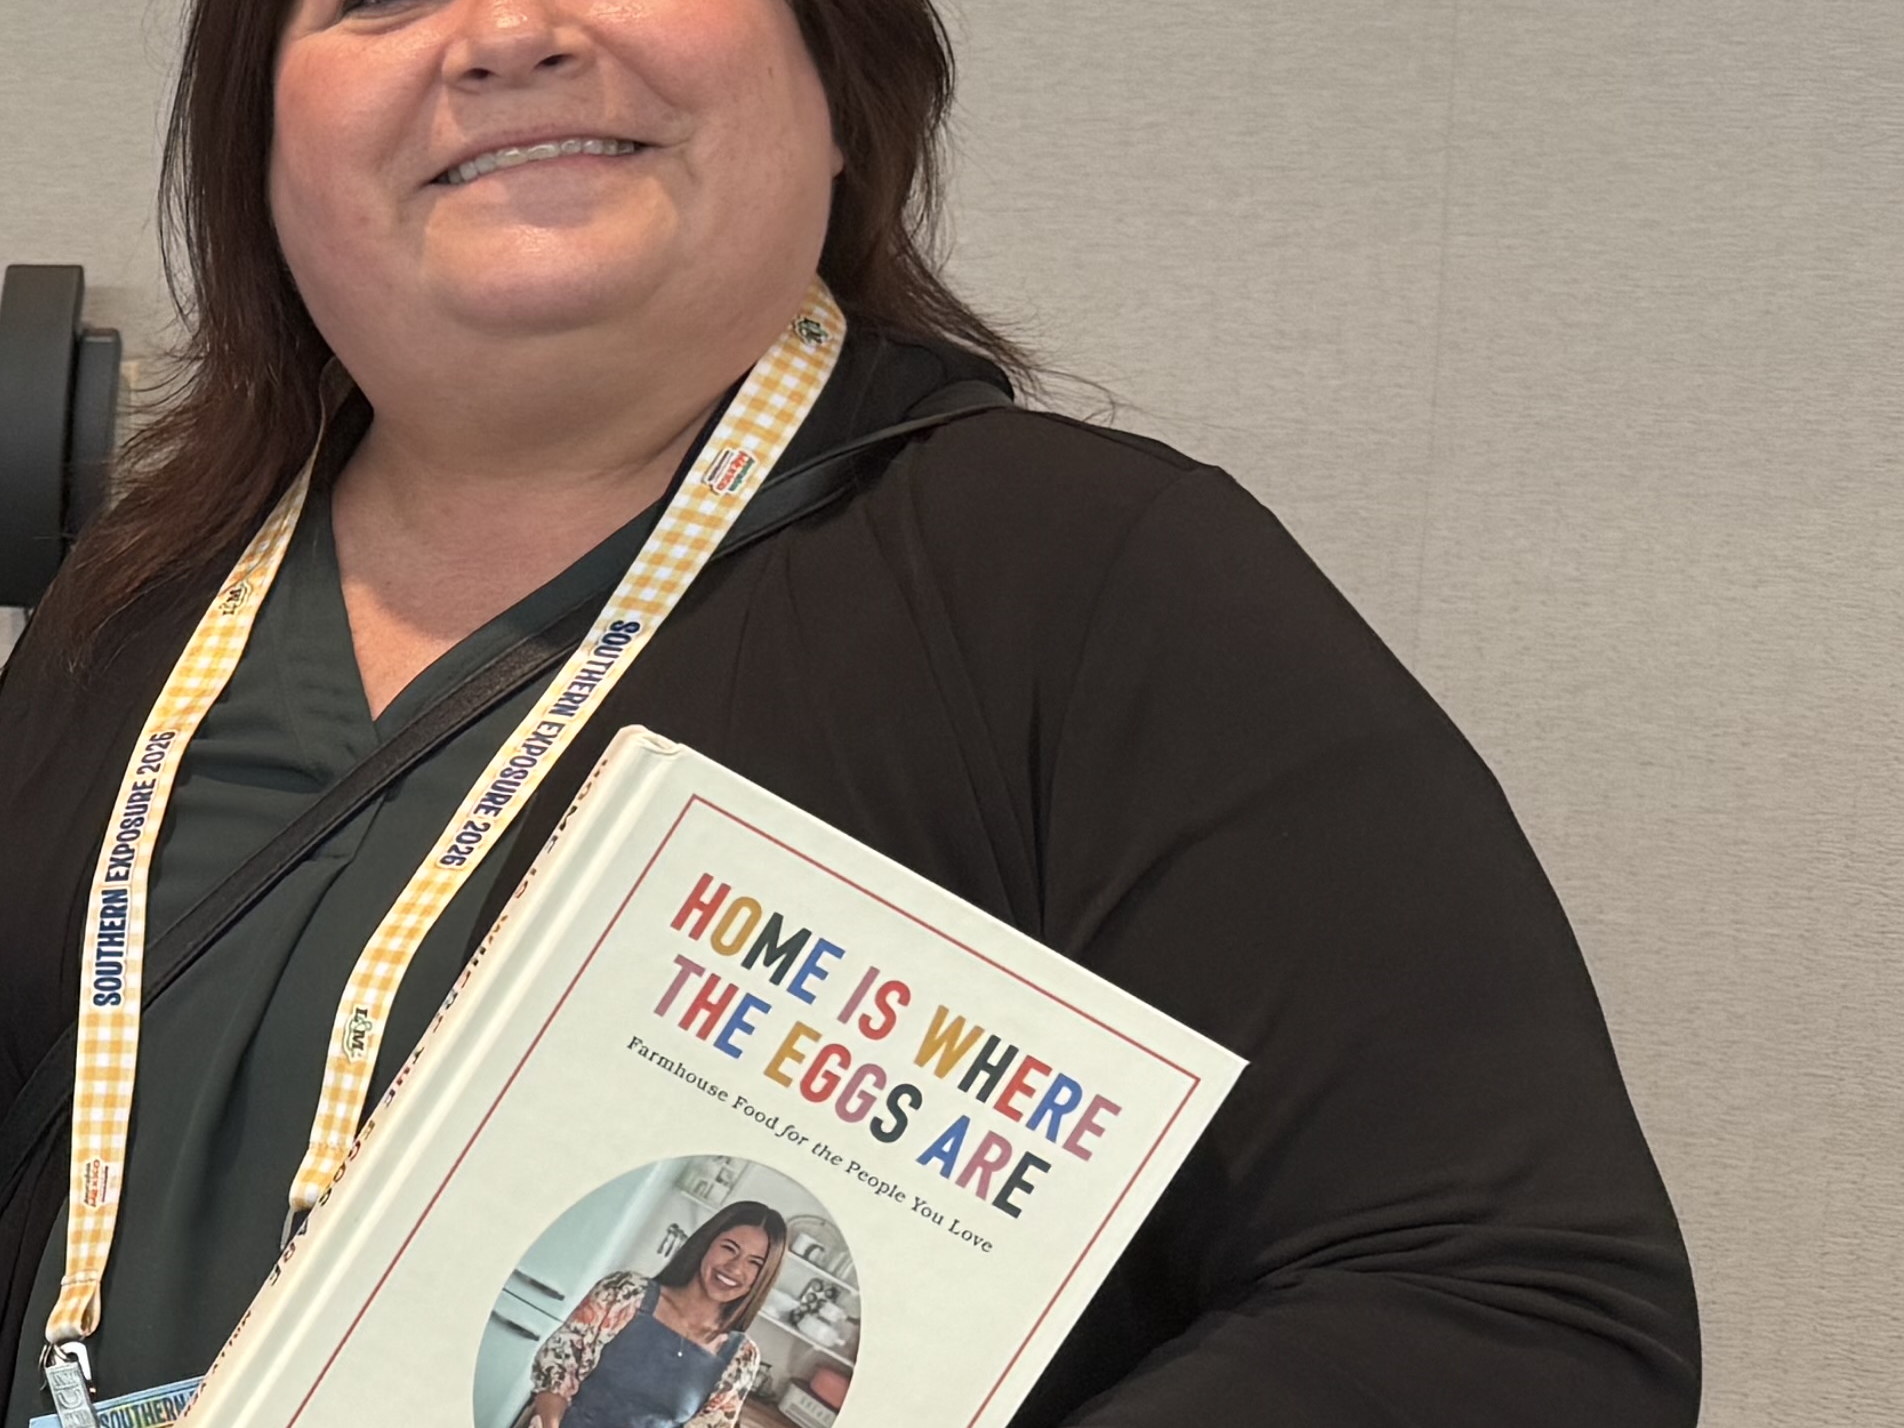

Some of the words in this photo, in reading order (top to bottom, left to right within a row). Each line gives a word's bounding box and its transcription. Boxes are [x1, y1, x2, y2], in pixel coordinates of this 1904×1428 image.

[553, 619, 641, 719] SOUTHERN
[136, 730, 176, 775] 2026
[473, 721, 561, 819] EXPOSURE
[104, 778, 157, 883] EXPOSURE
[439, 820, 492, 867] 2026
[92, 888, 128, 1007] SOUTHERN
[670, 872, 846, 1005] HOME
[837, 966, 912, 1041] IS
[913, 1005, 1123, 1163] WHERE
[653, 953, 772, 1060] THE
[763, 1020, 924, 1144] EGGS
[916, 1114, 1053, 1220] ARE
[626, 1035, 730, 1105] Farmhouse
[731, 1094, 780, 1132] Food
[776, 1123, 810, 1148] for
[811, 1140, 845, 1169] the
[845, 1159, 907, 1204] People
[911, 1195, 945, 1228] You
[949, 1218, 995, 1255] Love
